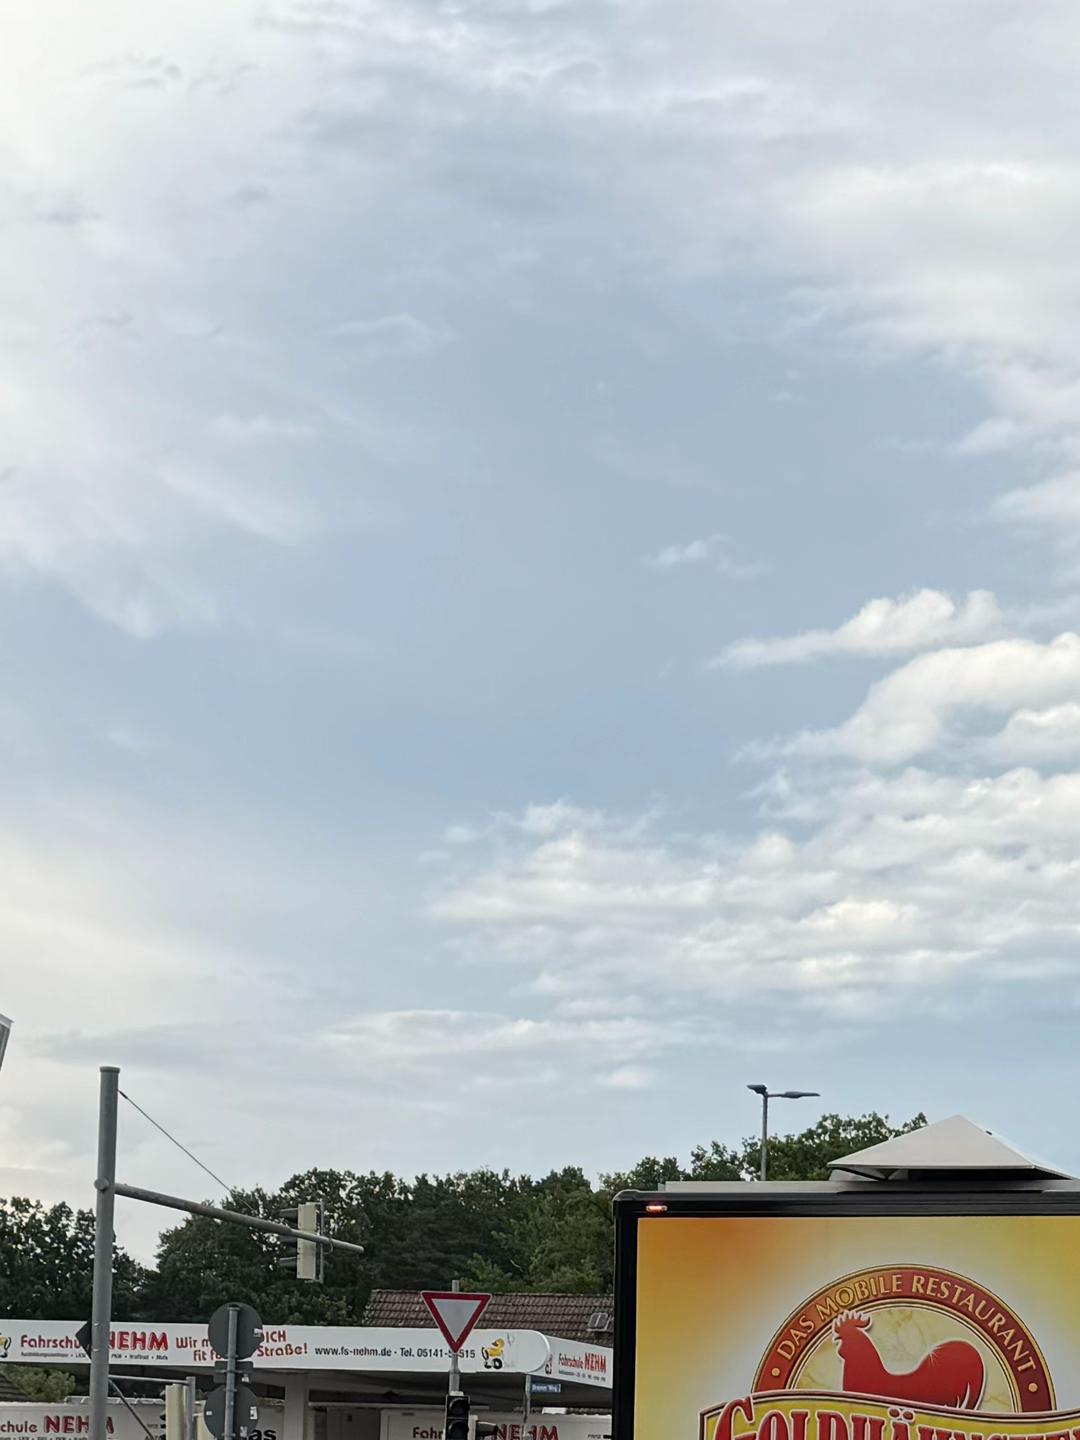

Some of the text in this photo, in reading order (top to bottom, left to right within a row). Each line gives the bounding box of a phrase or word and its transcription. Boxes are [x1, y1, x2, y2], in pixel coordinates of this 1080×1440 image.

[777, 1274, 1037, 1373] DAS MOBILE RESTAURANT
[20, 1334, 82, 1349] Fahrschu
[176, 1336, 197, 1349] Wir
[257, 1343, 308, 1357] Straße!
[314, 1346, 476, 1359] www.fs-nehm.de Tel. 05141-5515
[584, 1352, 607, 1373] NEHM
